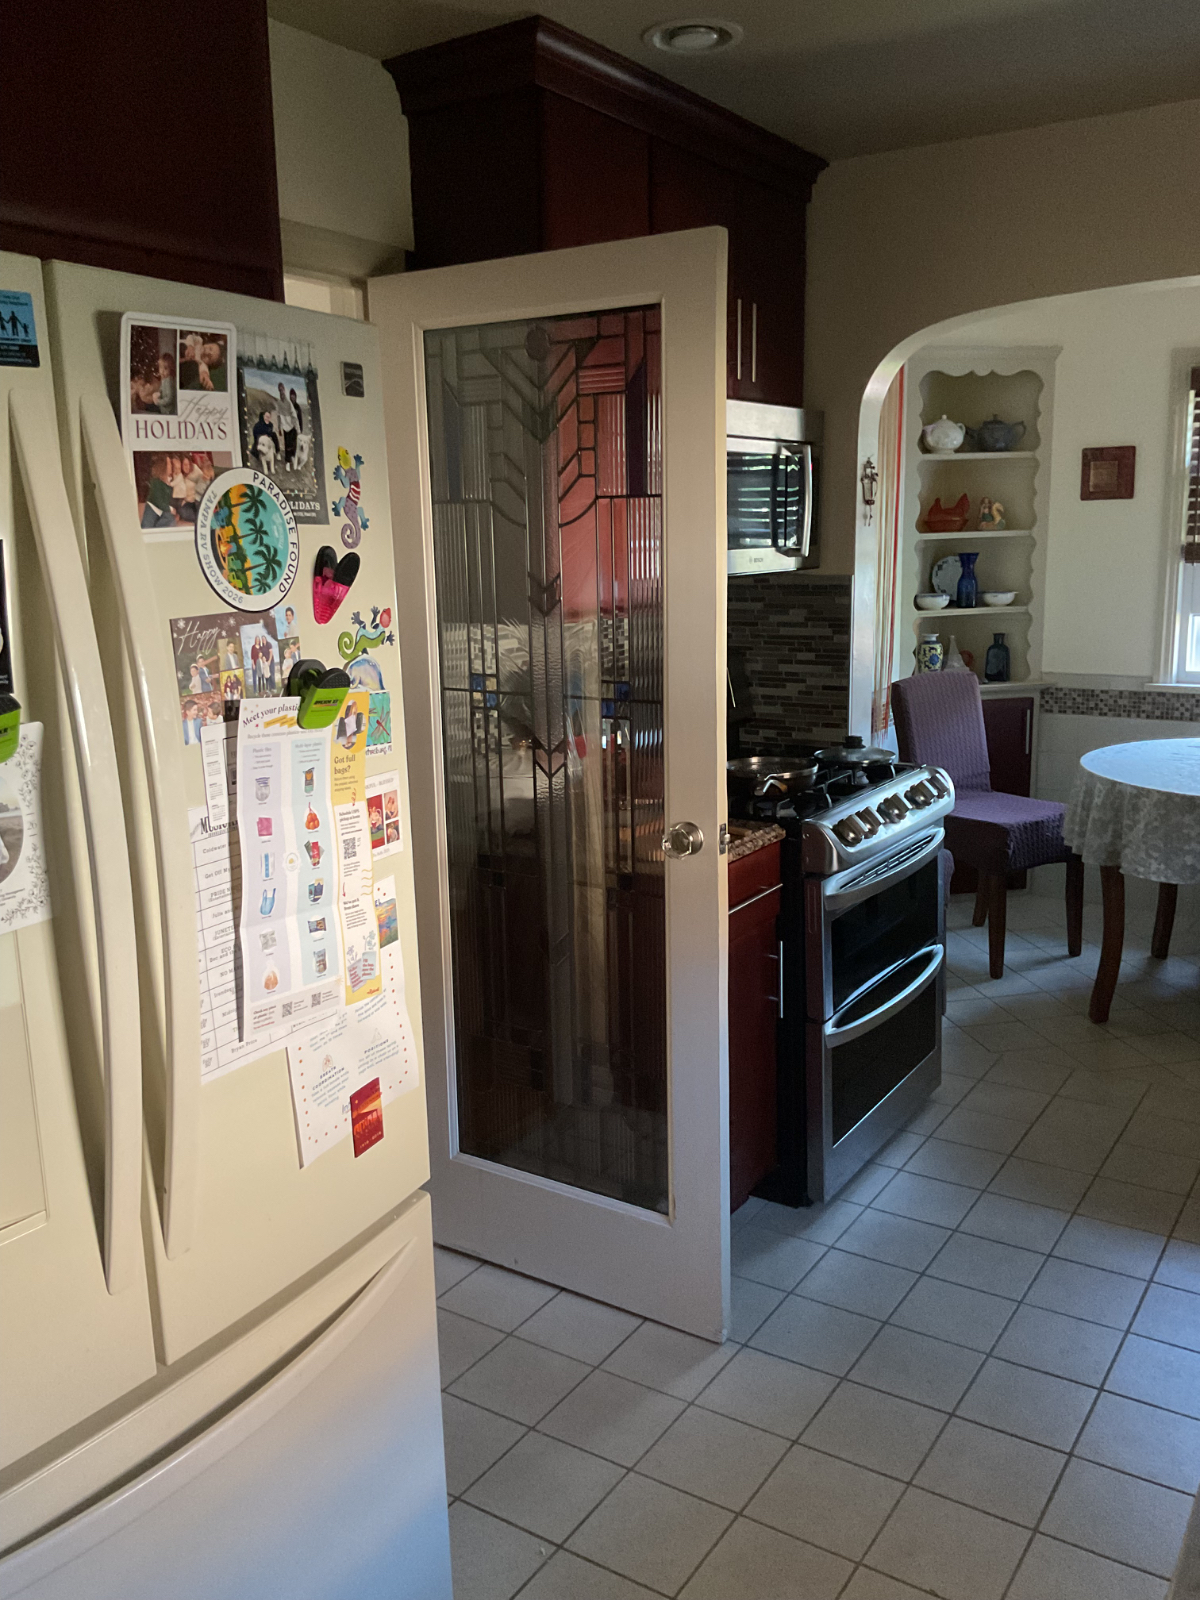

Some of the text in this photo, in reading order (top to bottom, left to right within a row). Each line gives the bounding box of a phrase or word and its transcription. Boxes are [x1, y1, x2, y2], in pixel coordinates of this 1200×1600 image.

[179, 393, 229, 424] Happy
[135, 419, 228, 440] HOLIDAYS
[251, 472, 298, 593] PARADISE FOUND
[200, 490, 244, 604] TAMPA RV SHOW 2026
[178, 621, 221, 656] Happy
[242, 712, 260, 727] Meet
[260, 707, 277, 720] your
[334, 754, 356, 764] Got full
[334, 765, 351, 775] bags?
[202, 844, 227, 854] Coldwater
[364, 1039, 389, 1054] POSITIONS
[312, 1067, 344, 1091] COORDINATION
[320, 1066, 336, 1079] BREATH
